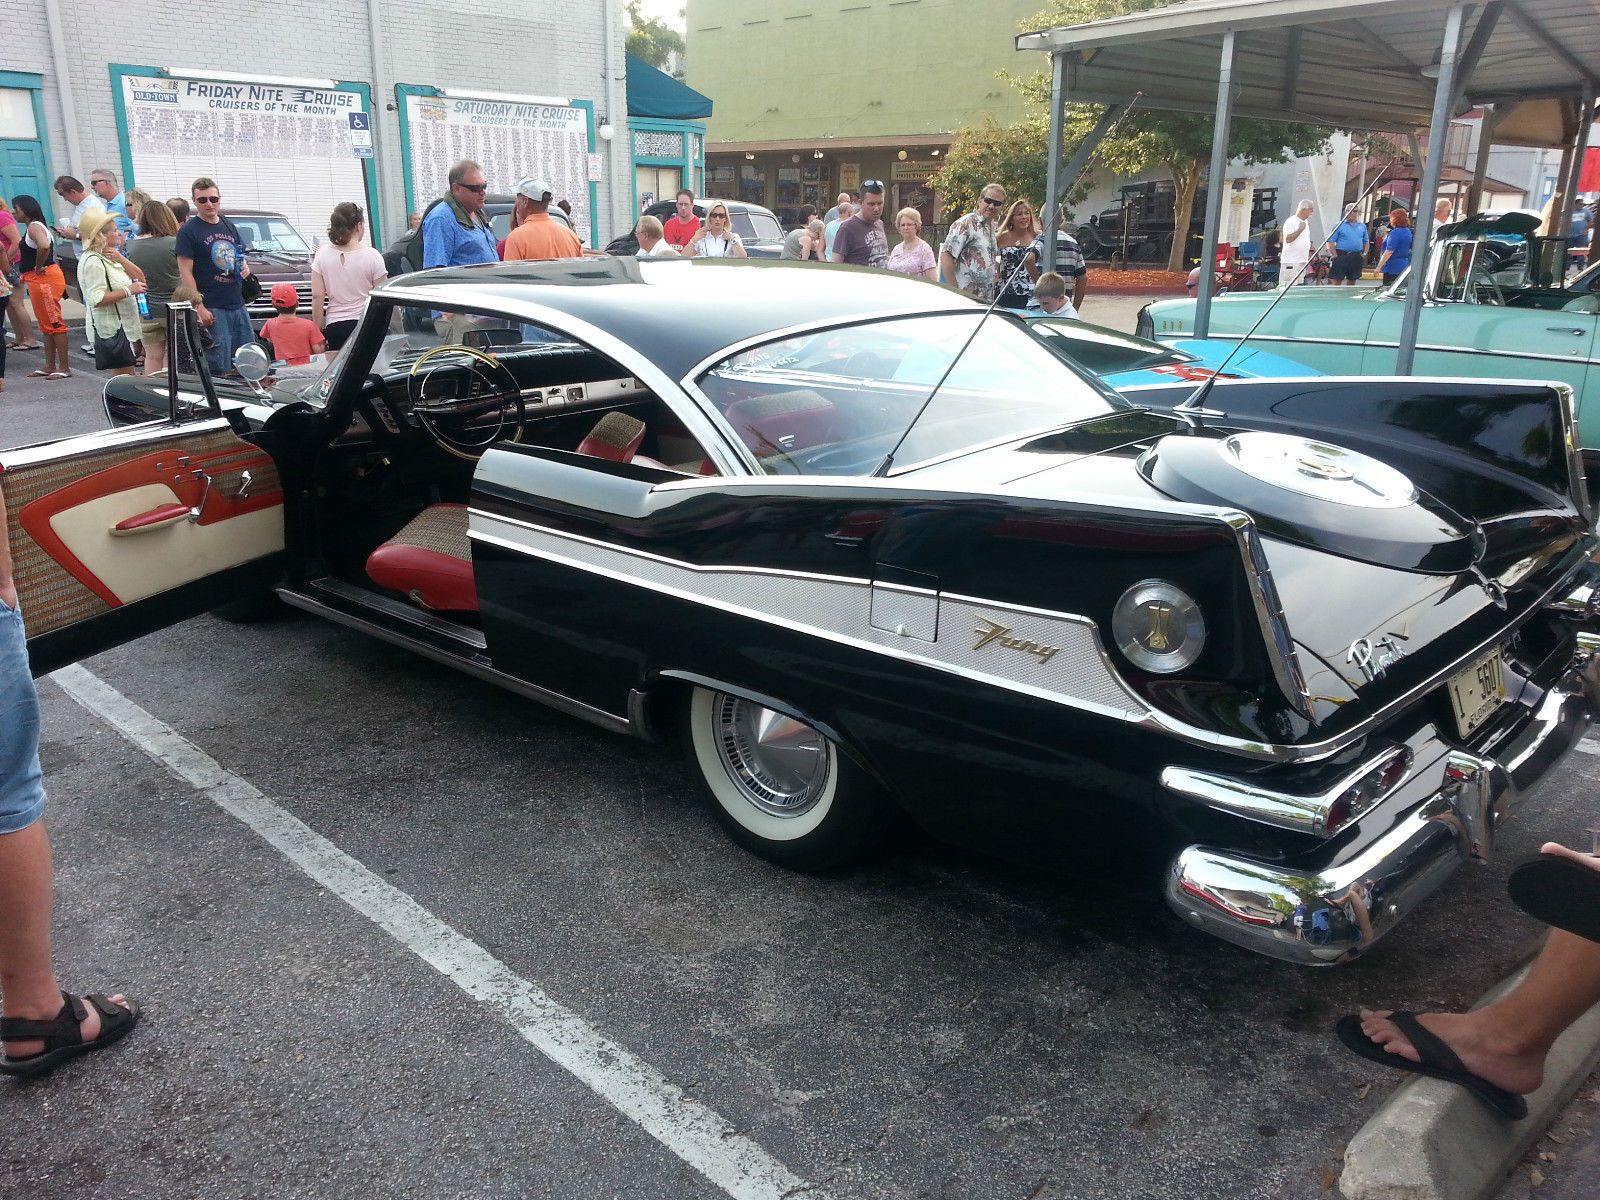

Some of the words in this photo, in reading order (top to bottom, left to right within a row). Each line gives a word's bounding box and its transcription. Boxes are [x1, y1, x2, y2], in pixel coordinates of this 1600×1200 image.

[186, 81, 243, 99] FRIDAY
[248, 85, 284, 102] NITE
[297, 89, 354, 107] CRUISE
[208, 99, 260, 111] CRUISERS
[264, 103, 277, 111] OF
[280, 103, 299, 113] THE
[303, 105, 337, 115] MONTH
[453, 101, 512, 116] SATURDAY
[514, 105, 540, 118] NITE
[541, 107, 581, 121] CRUISE
[470, 115, 509, 126] CRUISERS
[510, 118, 520, 126] OF
[523, 118, 537, 128] THE
[538, 119, 567, 129] MONTH
[972, 613, 1060, 665] Fury
